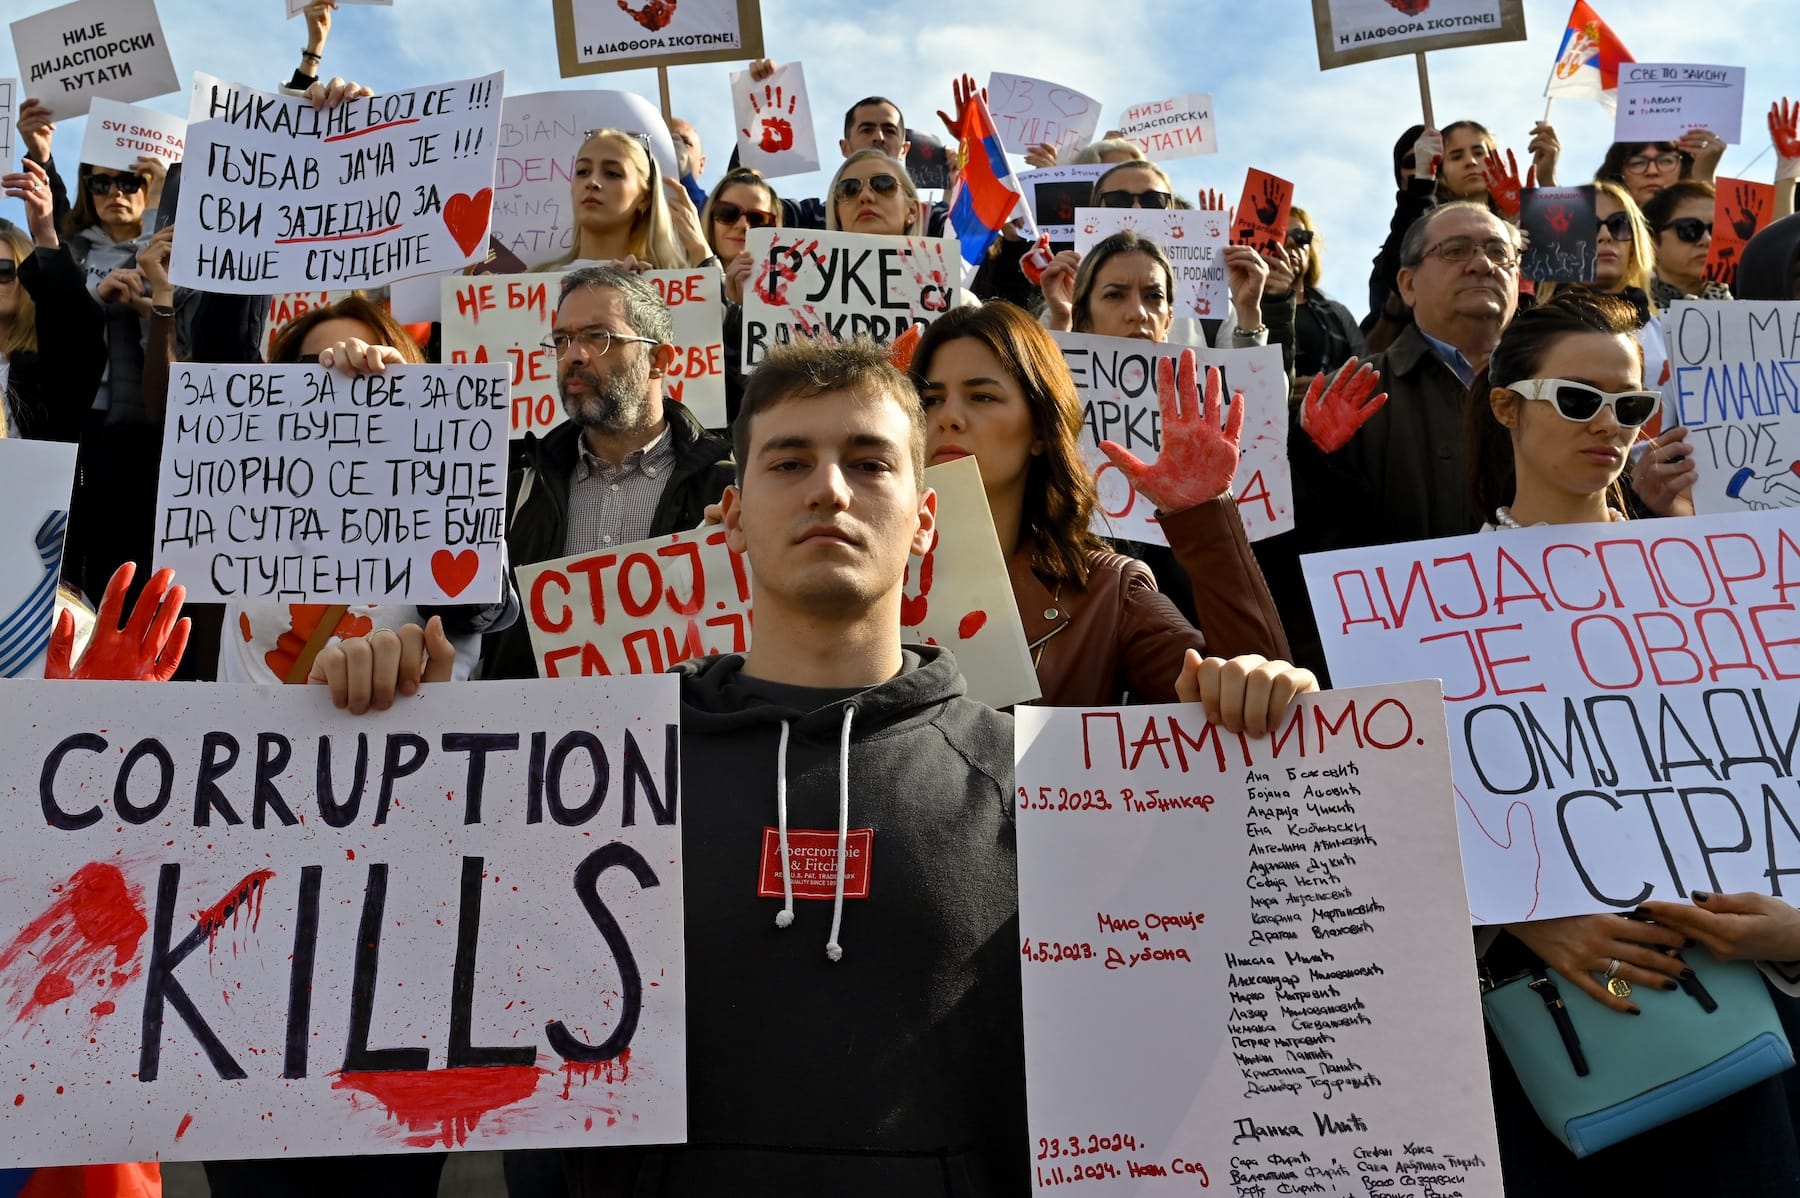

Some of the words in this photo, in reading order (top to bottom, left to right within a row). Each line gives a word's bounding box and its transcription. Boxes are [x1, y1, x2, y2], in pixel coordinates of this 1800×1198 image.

[62, 22, 107, 46] НИЈЕ
[1354, 23, 1424, 42] ΔΙΑΦΘΟΡΑ
[1428, 13, 1495, 30] ΣΚΟΤΩΝΕΙ
[30, 33, 155, 81] ДИЈАСПОРСКИ
[597, 38, 665, 55] ΔΙΑΦΘΟΡΑ
[668, 33, 734, 47] ΣΚΟΤΩΝΕΙ
[60, 62, 132, 92] ЋУТАТИ
[211, 85, 322, 139] НИКАД
[327, 98, 359, 136] НЕ
[367, 93, 415, 128] БОЈ
[422, 88, 456, 116] СЕ
[1128, 100, 1175, 120] НИЈЕ
[102, 121, 126, 133] SVI
[130, 126, 162, 140] SMO
[166, 135, 183, 149] SA
[1127, 125, 1203, 154] УТАТИ
[208, 142, 320, 191] ЉУБАВ
[339, 142, 394, 185] ЈАЧА
[408, 134, 440, 167] ЈЕ
[200, 194, 262, 238] СВИ
[277, 191, 401, 238] ЗАЈЕДНО
[412, 184, 441, 216] ЗА
[198, 244, 280, 281] НАШЕ
[305, 233, 432, 282] СТУДЕНТЕ
[768, 245, 912, 309] РУКЕ
[1184, 266, 1224, 281] PODANICI
[457, 284, 496, 324] НЕ
[507, 282, 546, 322] БИ
[507, 342, 552, 387] ЈЕ
[181, 372, 216, 406] ЗА
[301, 372, 339, 406] ЗА
[419, 375, 453, 408] ЗА
[456, 376, 509, 409] СВЕ
[177, 413, 263, 444] МОЈЕ
[279, 411, 391, 451] ЉУДЕ
[413, 418, 492, 452] ШТО
[1691, 422, 1783, 469] ΤΟΥΣ
[173, 456, 314, 497] УПОРНО
[329, 460, 374, 496] СЕ
[385, 458, 502, 506] ТРУДЕ
[161, 507, 216, 552] ДА
[228, 505, 330, 543] СУТРА
[341, 507, 431, 546] БОЉЕ
[445, 507, 504, 550] БУДЕ
[211, 553, 412, 602] СТУДЕНТИ
[1420, 622, 1547, 702] ЈЕ
[1570, 602, 1800, 690] ОВДЕ
[39, 724, 679, 830] CORRUPTION
[1245, 770, 1270, 784] Ана
[1017, 786, 1113, 812] 3.5.2023.
[1120, 787, 1215, 813] Рибникар
[1247, 787, 1290, 802] Бојана
[1247, 805, 1299, 821] Андрија
[1306, 799, 1355, 816] Чикић
[1245, 822, 1272, 838] Ема
[1248, 842, 1307, 857] Ангелина
[1306, 852, 1357, 875] Дукић
[791, 860, 801, 871] &
[1250, 896, 1279, 909] Мара
[1097, 912, 1139, 933] Мало
[1144, 911, 1205, 932] Орашје
[1251, 911, 1302, 926] Катарина
[1249, 930, 1298, 947] Драган
[138, 841, 661, 1082] KILLS
[1021, 937, 1097, 962] 4.5.2023.
[1104, 947, 1192, 970] Дубона
[1228, 973, 1300, 991] Александар
[1229, 1007, 1269, 1022] Лазар
[1241, 1067, 1306, 1080] Кристина
[1232, 1117, 1304, 1145] Данка
[1037, 1133, 1145, 1160] 23.3.2024.
[1403, 1141, 1434, 1156] Хрка
[1037, 1162, 1121, 1188] 1.11.2024.
[1172, 1158, 1209, 1188] Сад
[1230, 1156, 1259, 1170] Сара
